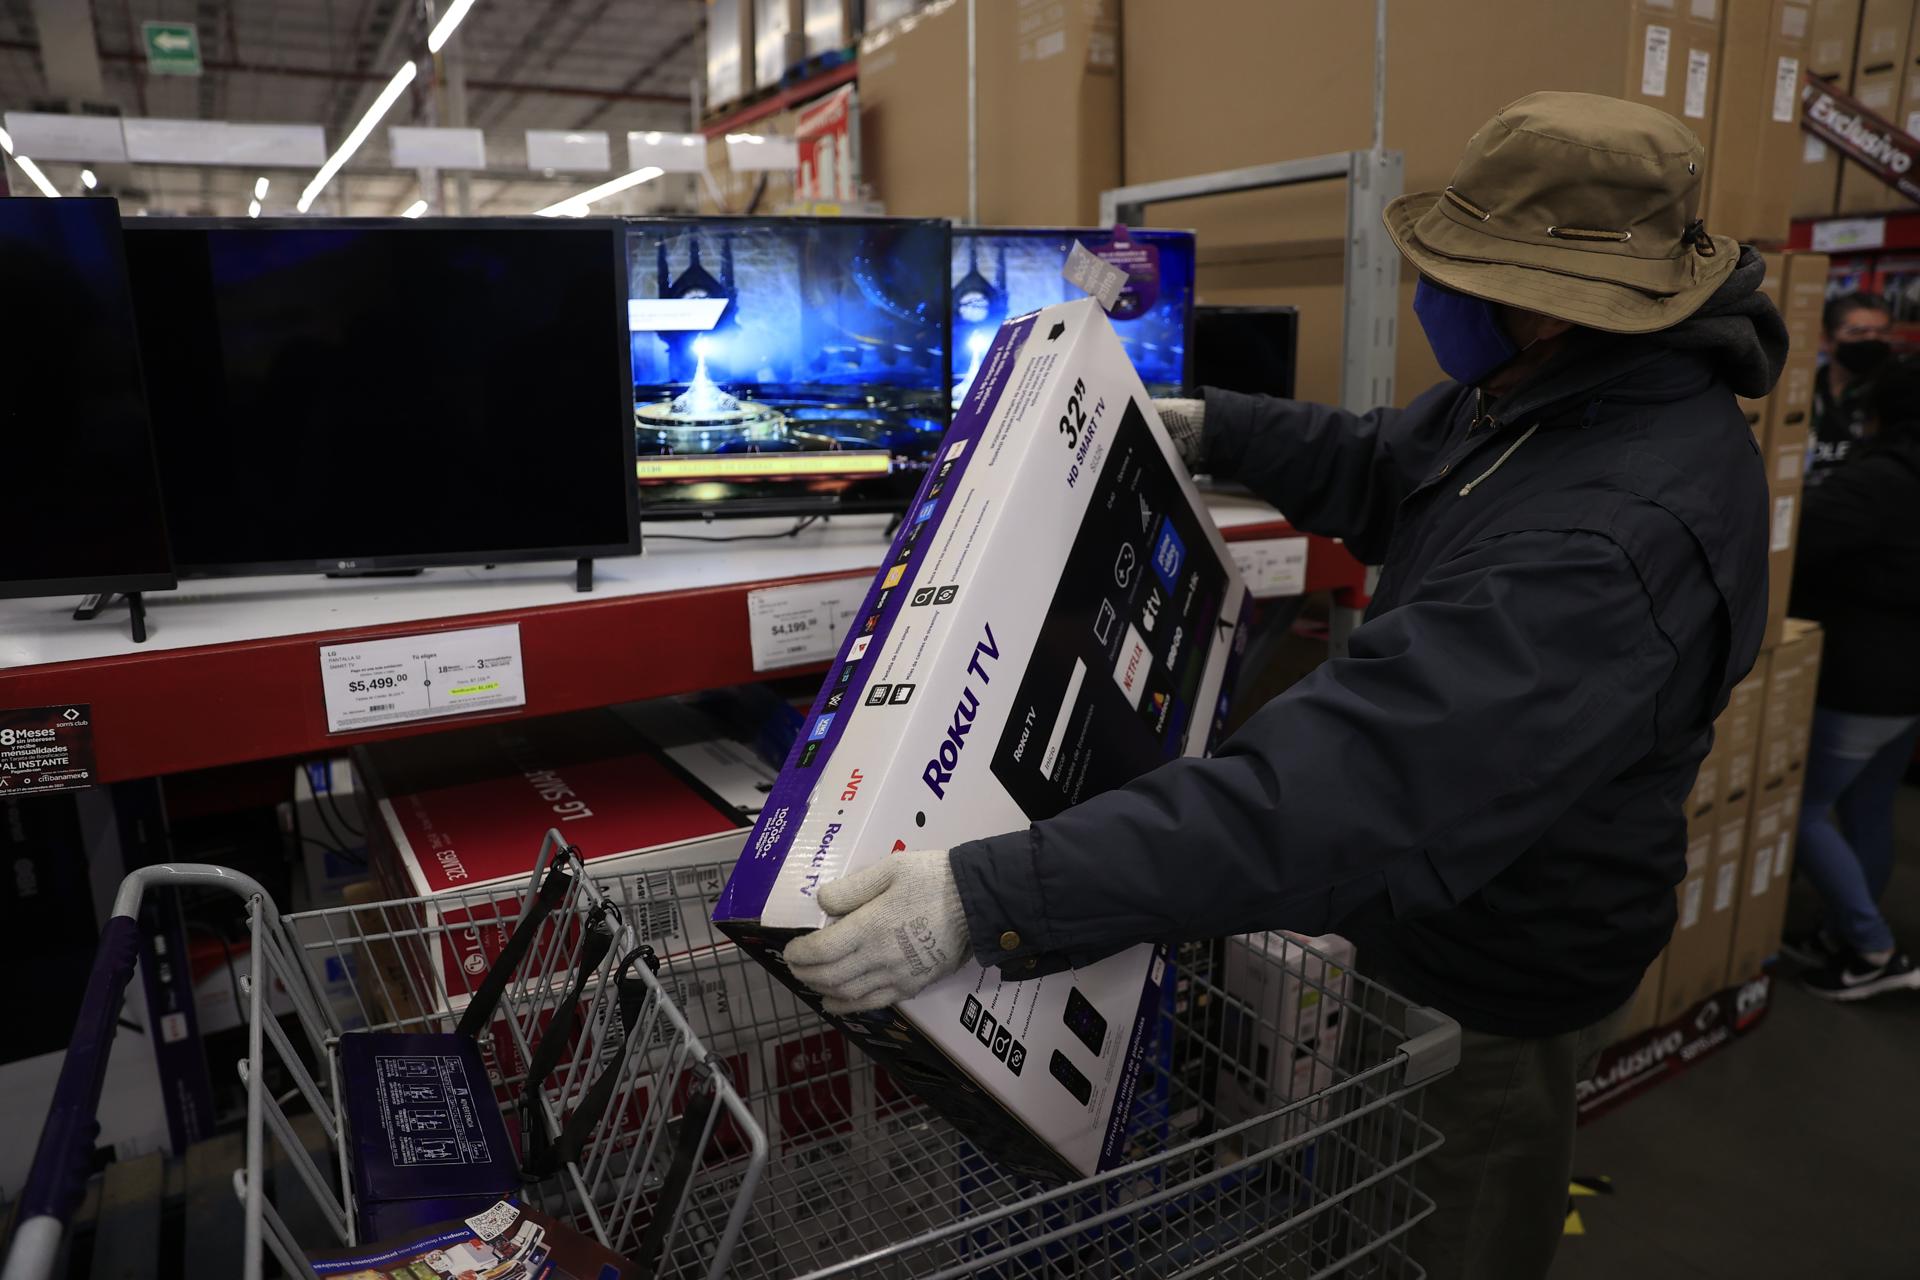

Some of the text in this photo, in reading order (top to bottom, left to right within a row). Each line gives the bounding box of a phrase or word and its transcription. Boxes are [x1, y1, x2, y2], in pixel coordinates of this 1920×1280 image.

[1809, 94, 1912, 173] Exclusivo
[1067, 396, 1105, 489] HD SMART TV
[477, 659, 485, 669] 3
[967, 621, 1000, 685] TV
[439, 666, 448, 674] 18
[1123, 642, 1144, 692] NETFLIX
[349, 673, 408, 693] $5,499.00
[1025, 705, 1036, 727] TV
[16, 728, 55, 739] Meses
[1, 745, 68, 757] mensualidades
[1044, 746, 1056, 770] Inicio
[3, 757, 69, 771] AL INSTANTE
[1053, 752, 1066, 783] Buscar
[38, 773, 81, 783] citibanamex
[841, 769, 863, 801] JVC
[553, 800, 594, 821] LG
[761, 805, 789, 860] 100,000+
[1106, 1016, 1145, 1157] Disfruta de miles de películas
[1119, 1046, 1145, 1134] y episodios de TV
[442, 1230, 470, 1241] Compra
